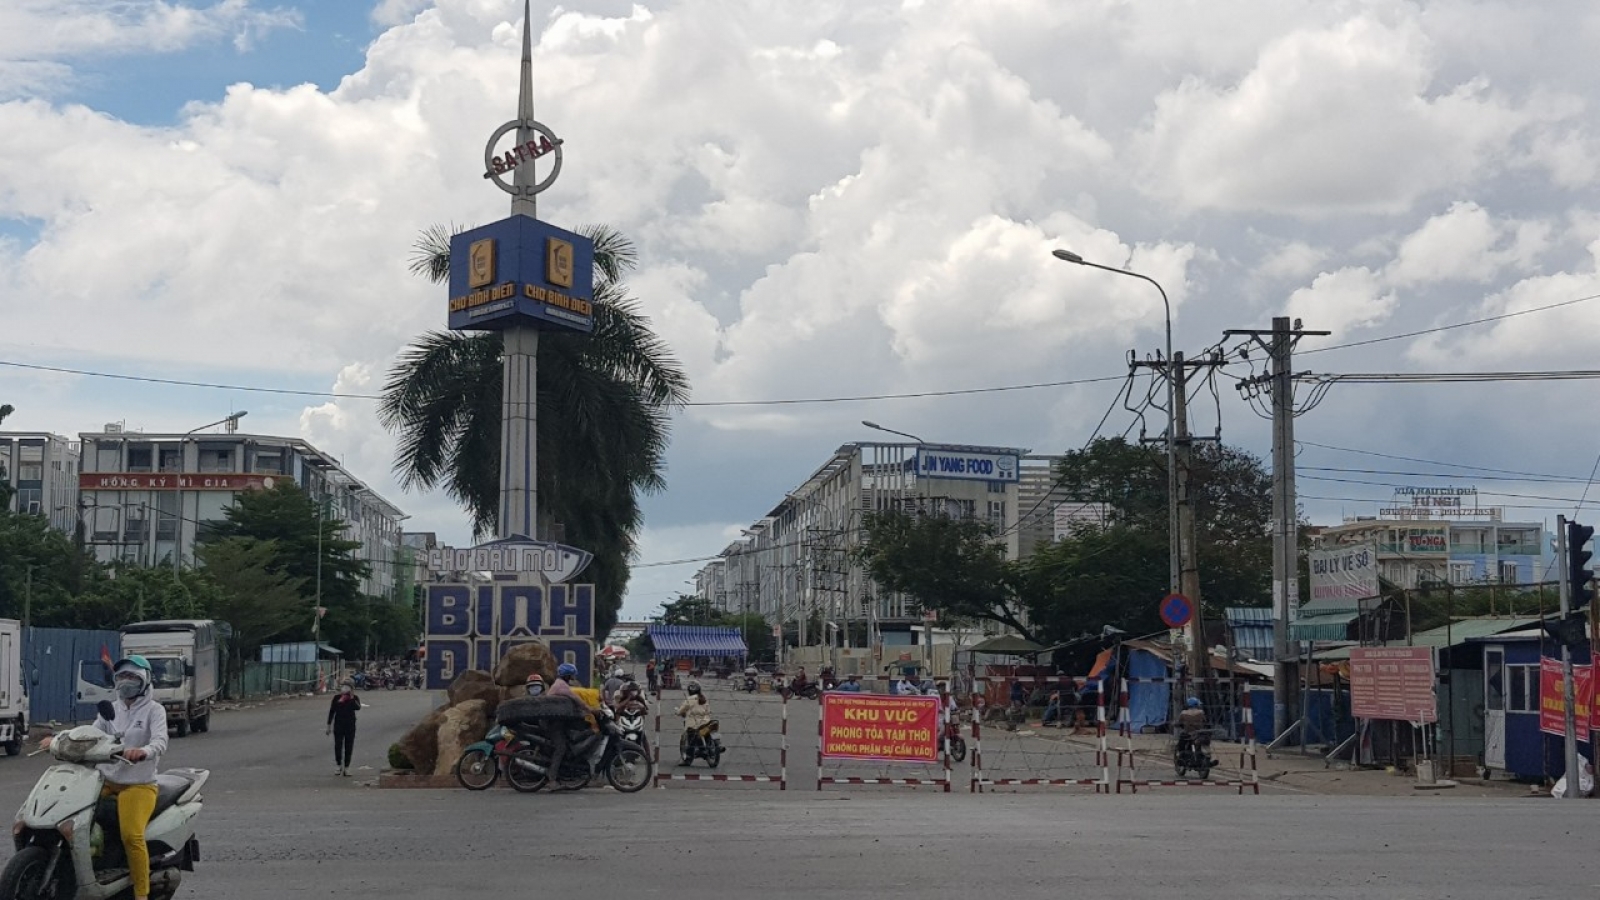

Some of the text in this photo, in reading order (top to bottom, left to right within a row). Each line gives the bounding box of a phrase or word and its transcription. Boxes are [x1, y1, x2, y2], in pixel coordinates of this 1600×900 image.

[492, 135, 555, 175] SATRA
[921, 455, 936, 471] JN
[939, 456, 965, 473] YANG
[966, 458, 993, 475] FOOD
[204, 478, 228, 487] GIA
[427, 575, 595, 637] BÌNH
[422, 639, 594, 691] ĐIN
[844, 708, 918, 725] KHU VỰC
[830, 724, 931, 743] PHONG TỎA TẠM THỜI
